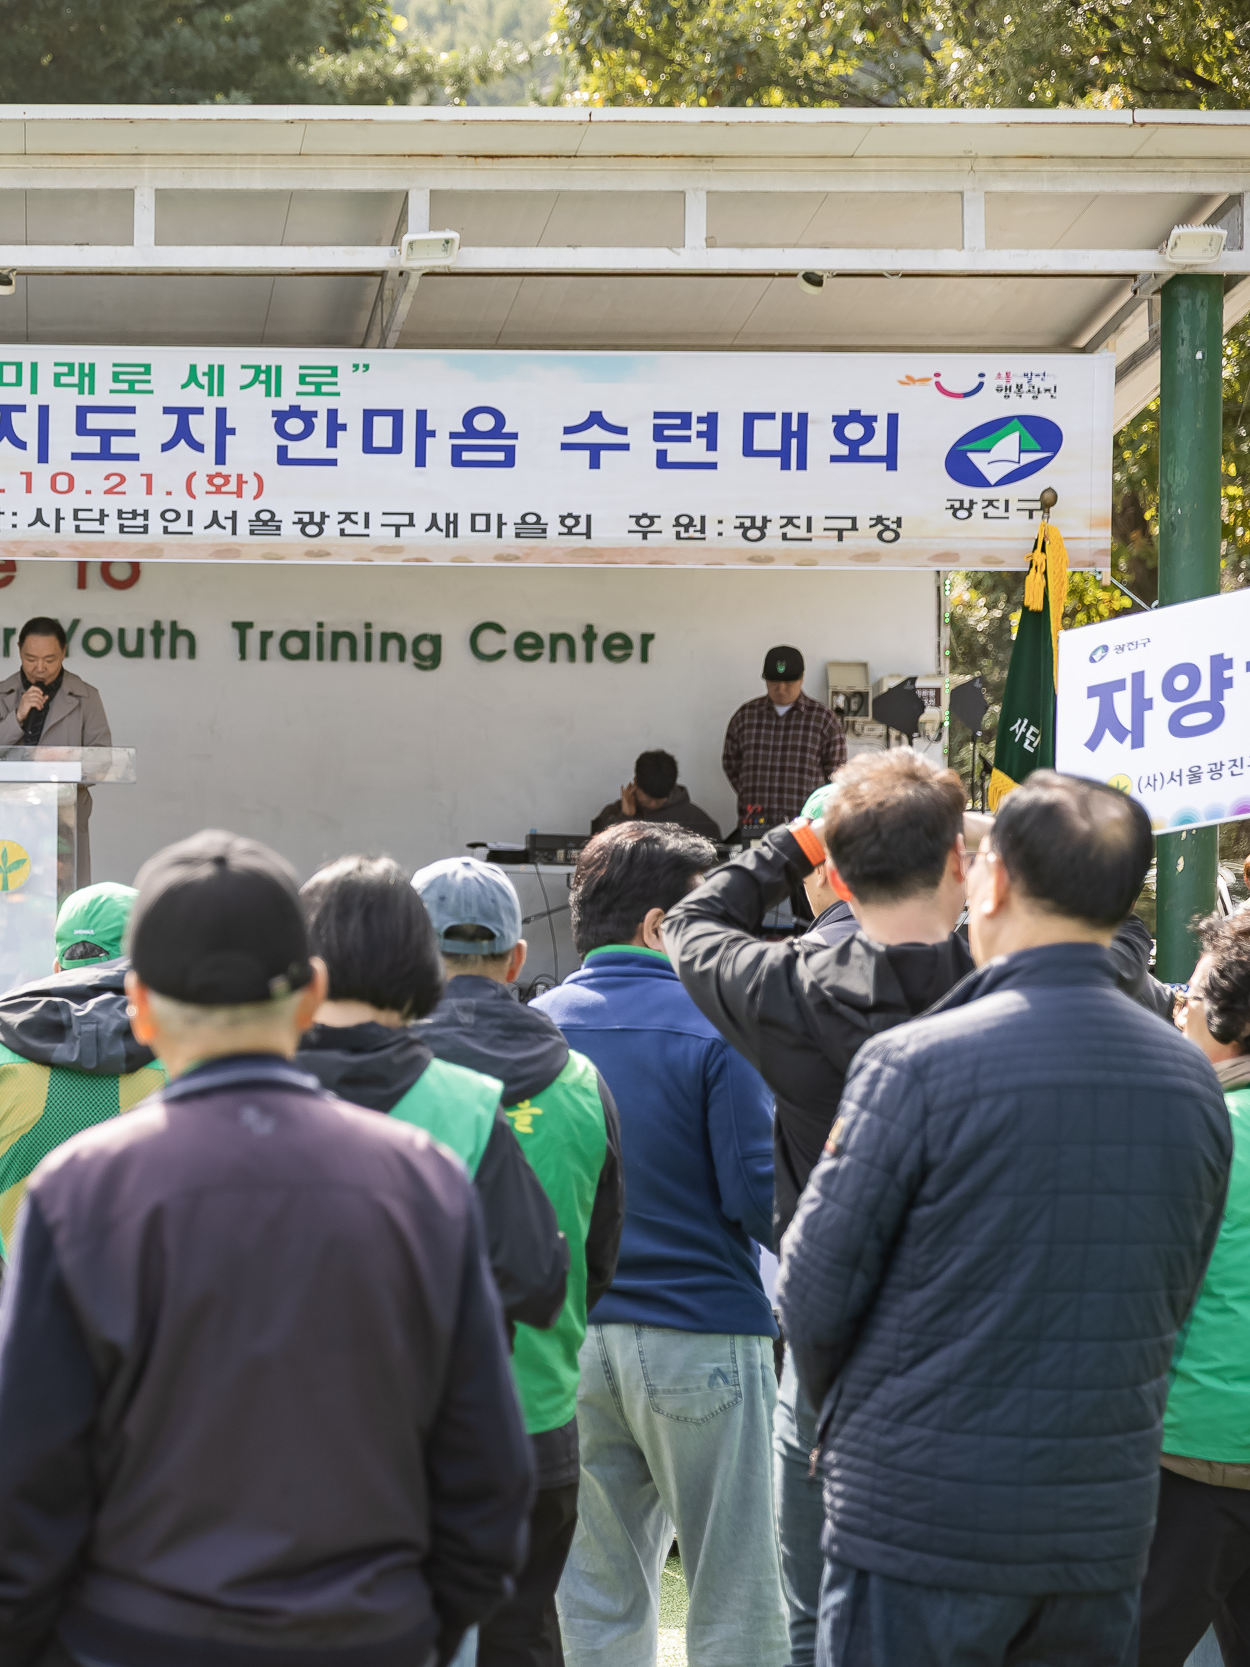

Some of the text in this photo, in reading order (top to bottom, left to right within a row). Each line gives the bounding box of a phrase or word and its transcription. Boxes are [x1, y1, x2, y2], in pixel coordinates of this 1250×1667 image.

[271, 405, 520, 468] 한마음
[560, 409, 899, 471] 수련대회
[627, 512, 903, 543] 후원:광진구청
[945, 497, 1043, 520] 광진구
[63, 618, 197, 660] Youth
[231, 621, 443, 671] Training
[469, 621, 656, 664] Center
[1113, 637, 1152, 655] 광진구
[1084, 652, 1250, 753] 자양
[1137, 755, 1250, 795] (사)서울광진
